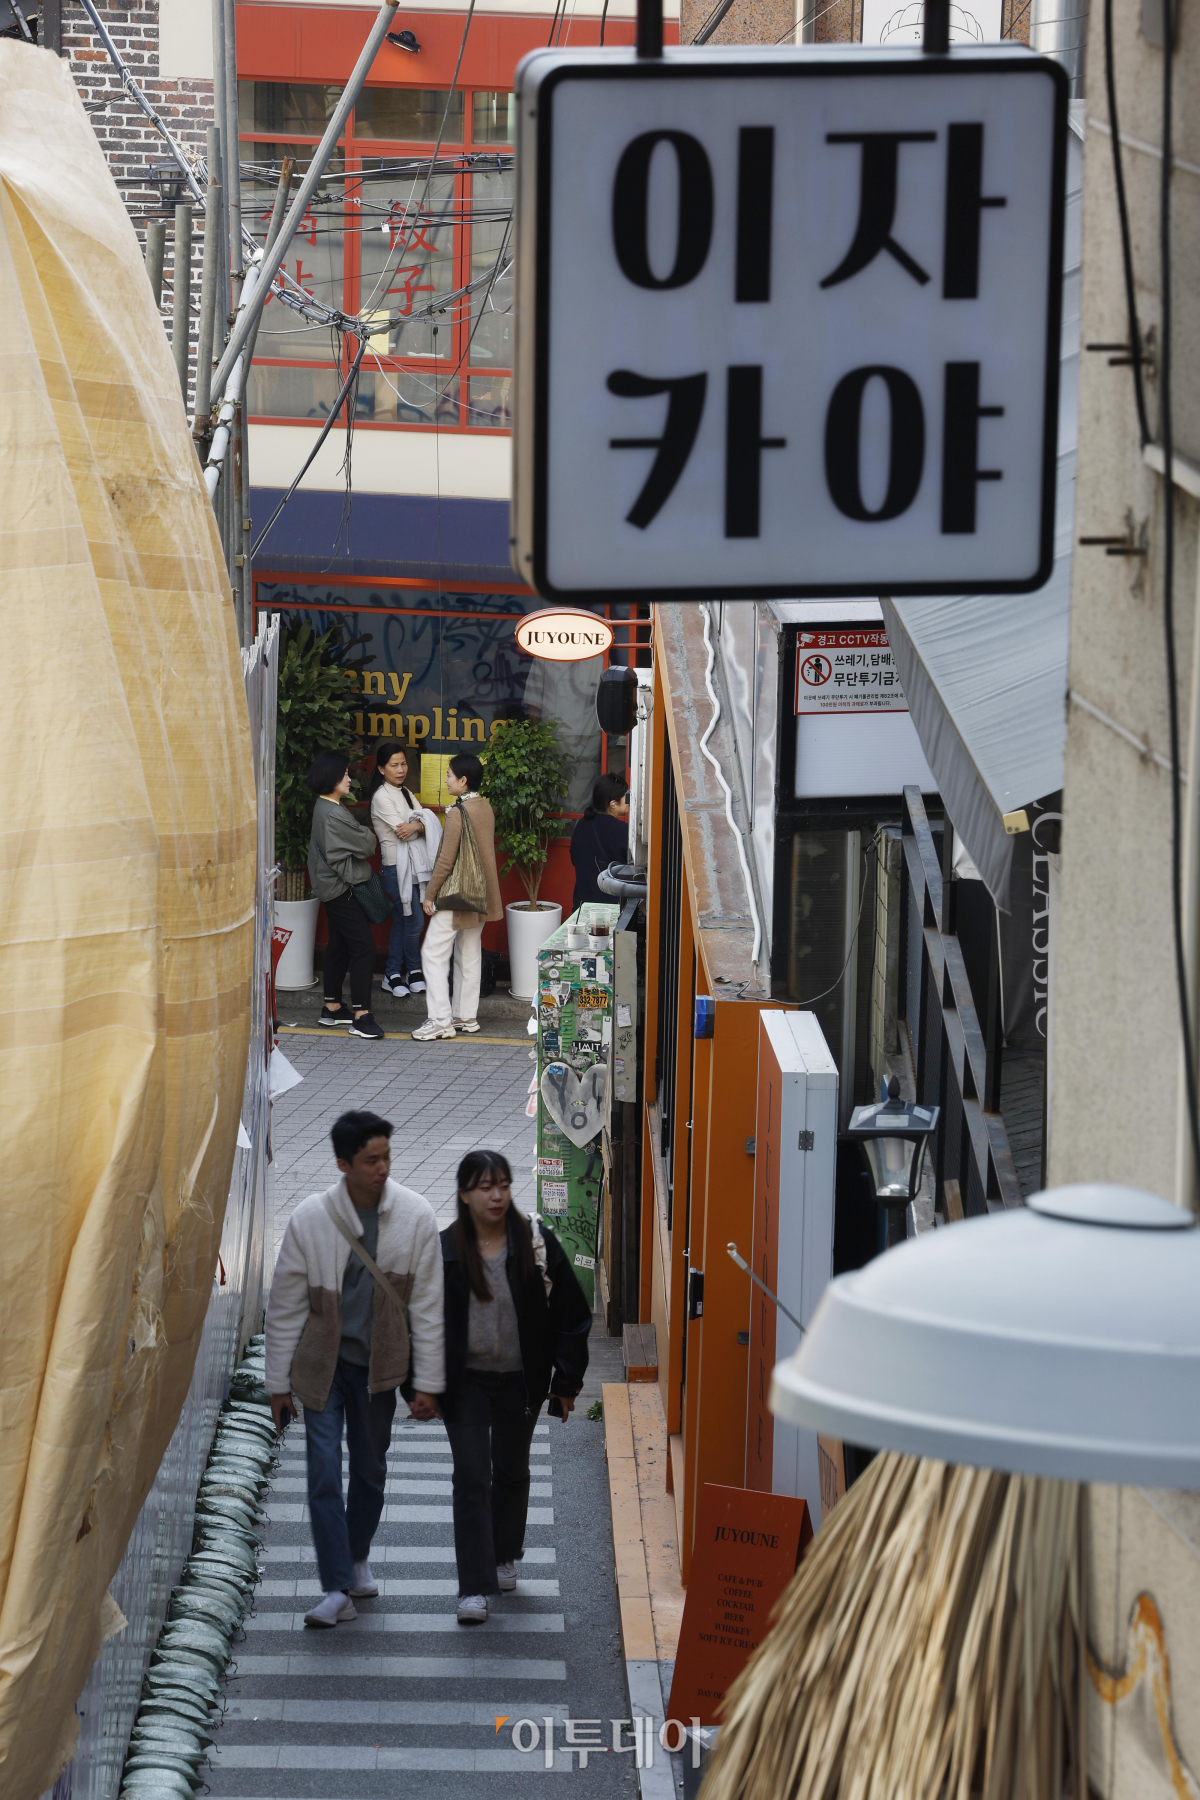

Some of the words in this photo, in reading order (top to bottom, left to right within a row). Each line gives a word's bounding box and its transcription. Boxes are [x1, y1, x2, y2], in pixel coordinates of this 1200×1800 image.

[612, 122, 1007, 303] 이자
[606, 361, 1005, 539] 카야
[526, 631, 605, 646] JUYOUNE
[817, 634, 837, 646] 경고
[834, 653, 895, 668] 쓰레기,담배
[714, 1526, 780, 1549] JUYOUNE
[717, 1573, 738, 1584] CAFE
[738, 1577, 745, 1585] &
[746, 1578, 763, 1588] PUB
[723, 1586, 753, 1598] COFFEE
[716, 1598, 756, 1612] COCKTAIL
[724, 1612, 745, 1623] BEER
[714, 1622, 752, 1636] WHISKEY
[698, 1633, 718, 1644] SOFT
[720, 1637, 732, 1646] ICE
[697, 1688, 712, 1698] DAY
